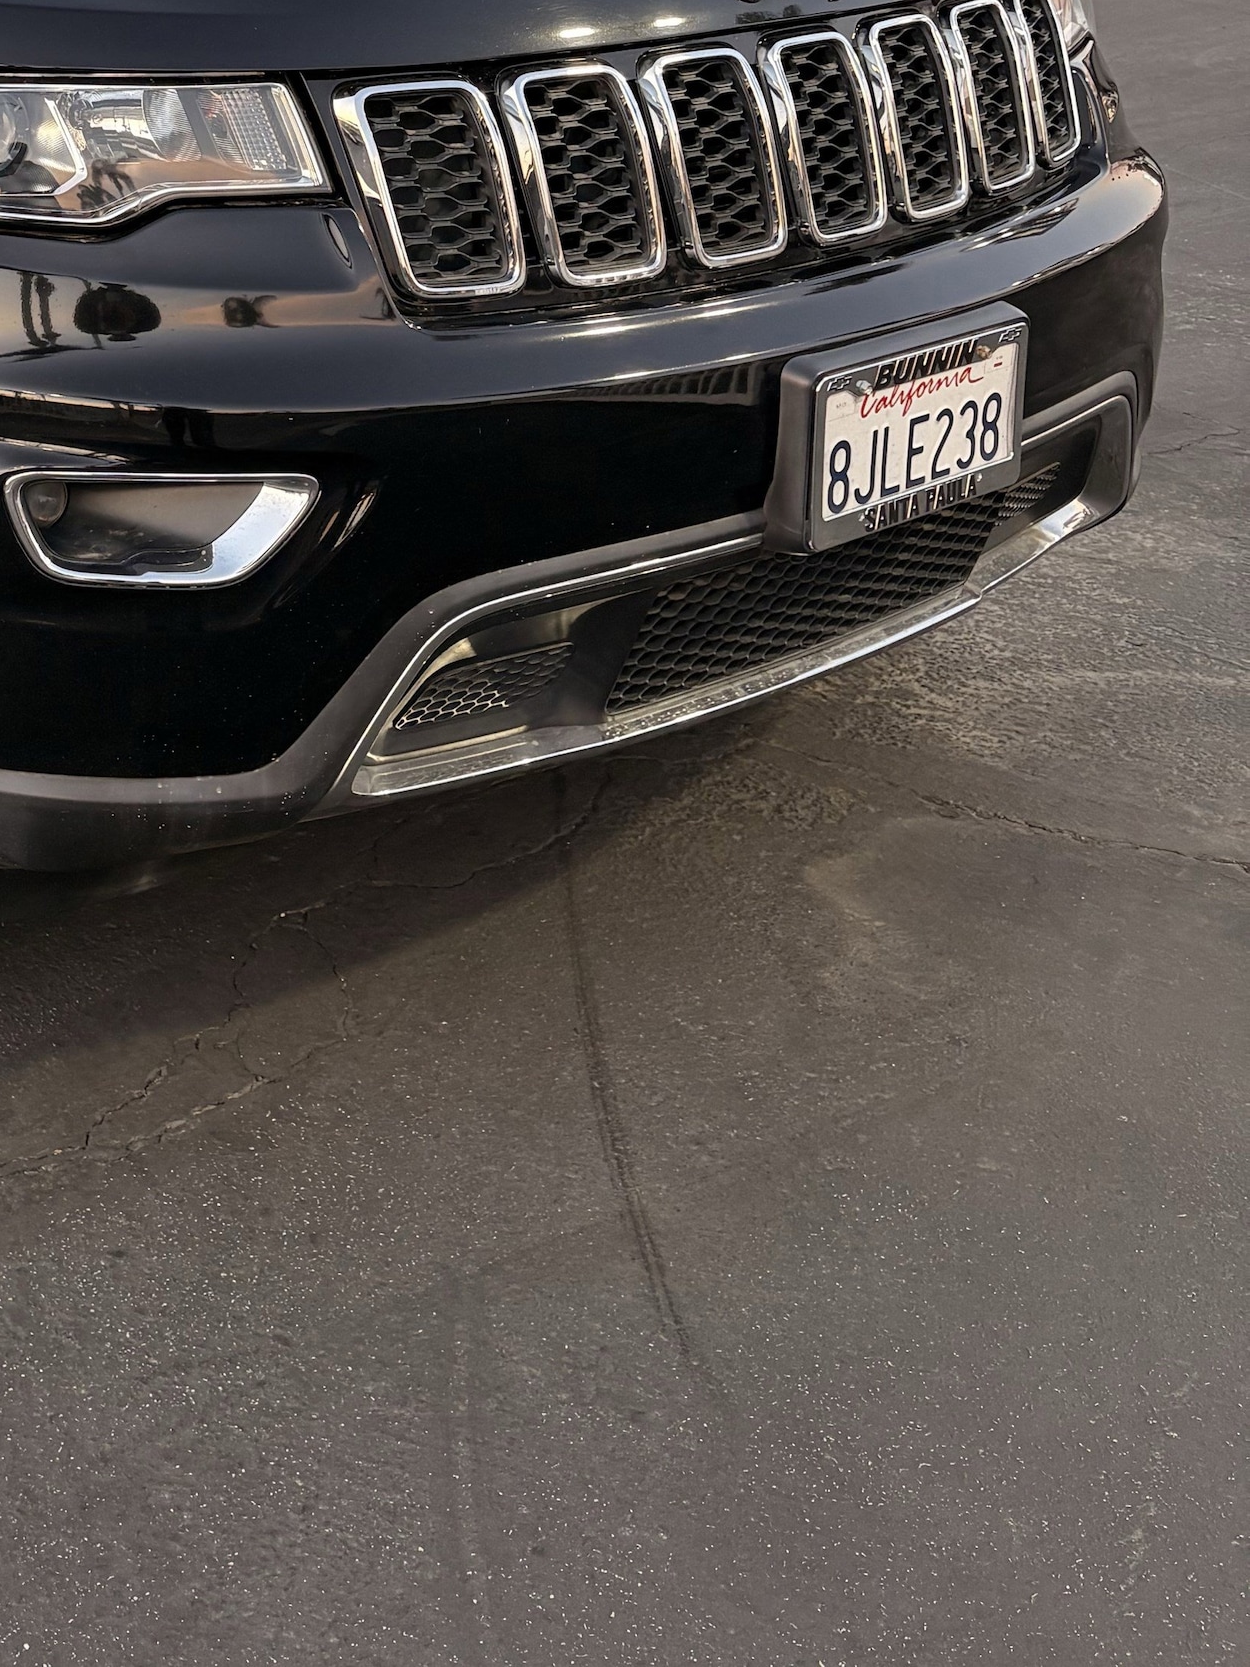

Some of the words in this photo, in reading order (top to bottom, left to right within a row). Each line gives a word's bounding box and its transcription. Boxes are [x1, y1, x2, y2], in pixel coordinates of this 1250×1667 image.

[859, 366, 985, 419] California
[872, 337, 980, 392] BUNNIN
[826, 392, 1003, 515] 8JLE238
[863, 493, 921, 533] SANTA
[923, 473, 978, 513] PAULA
